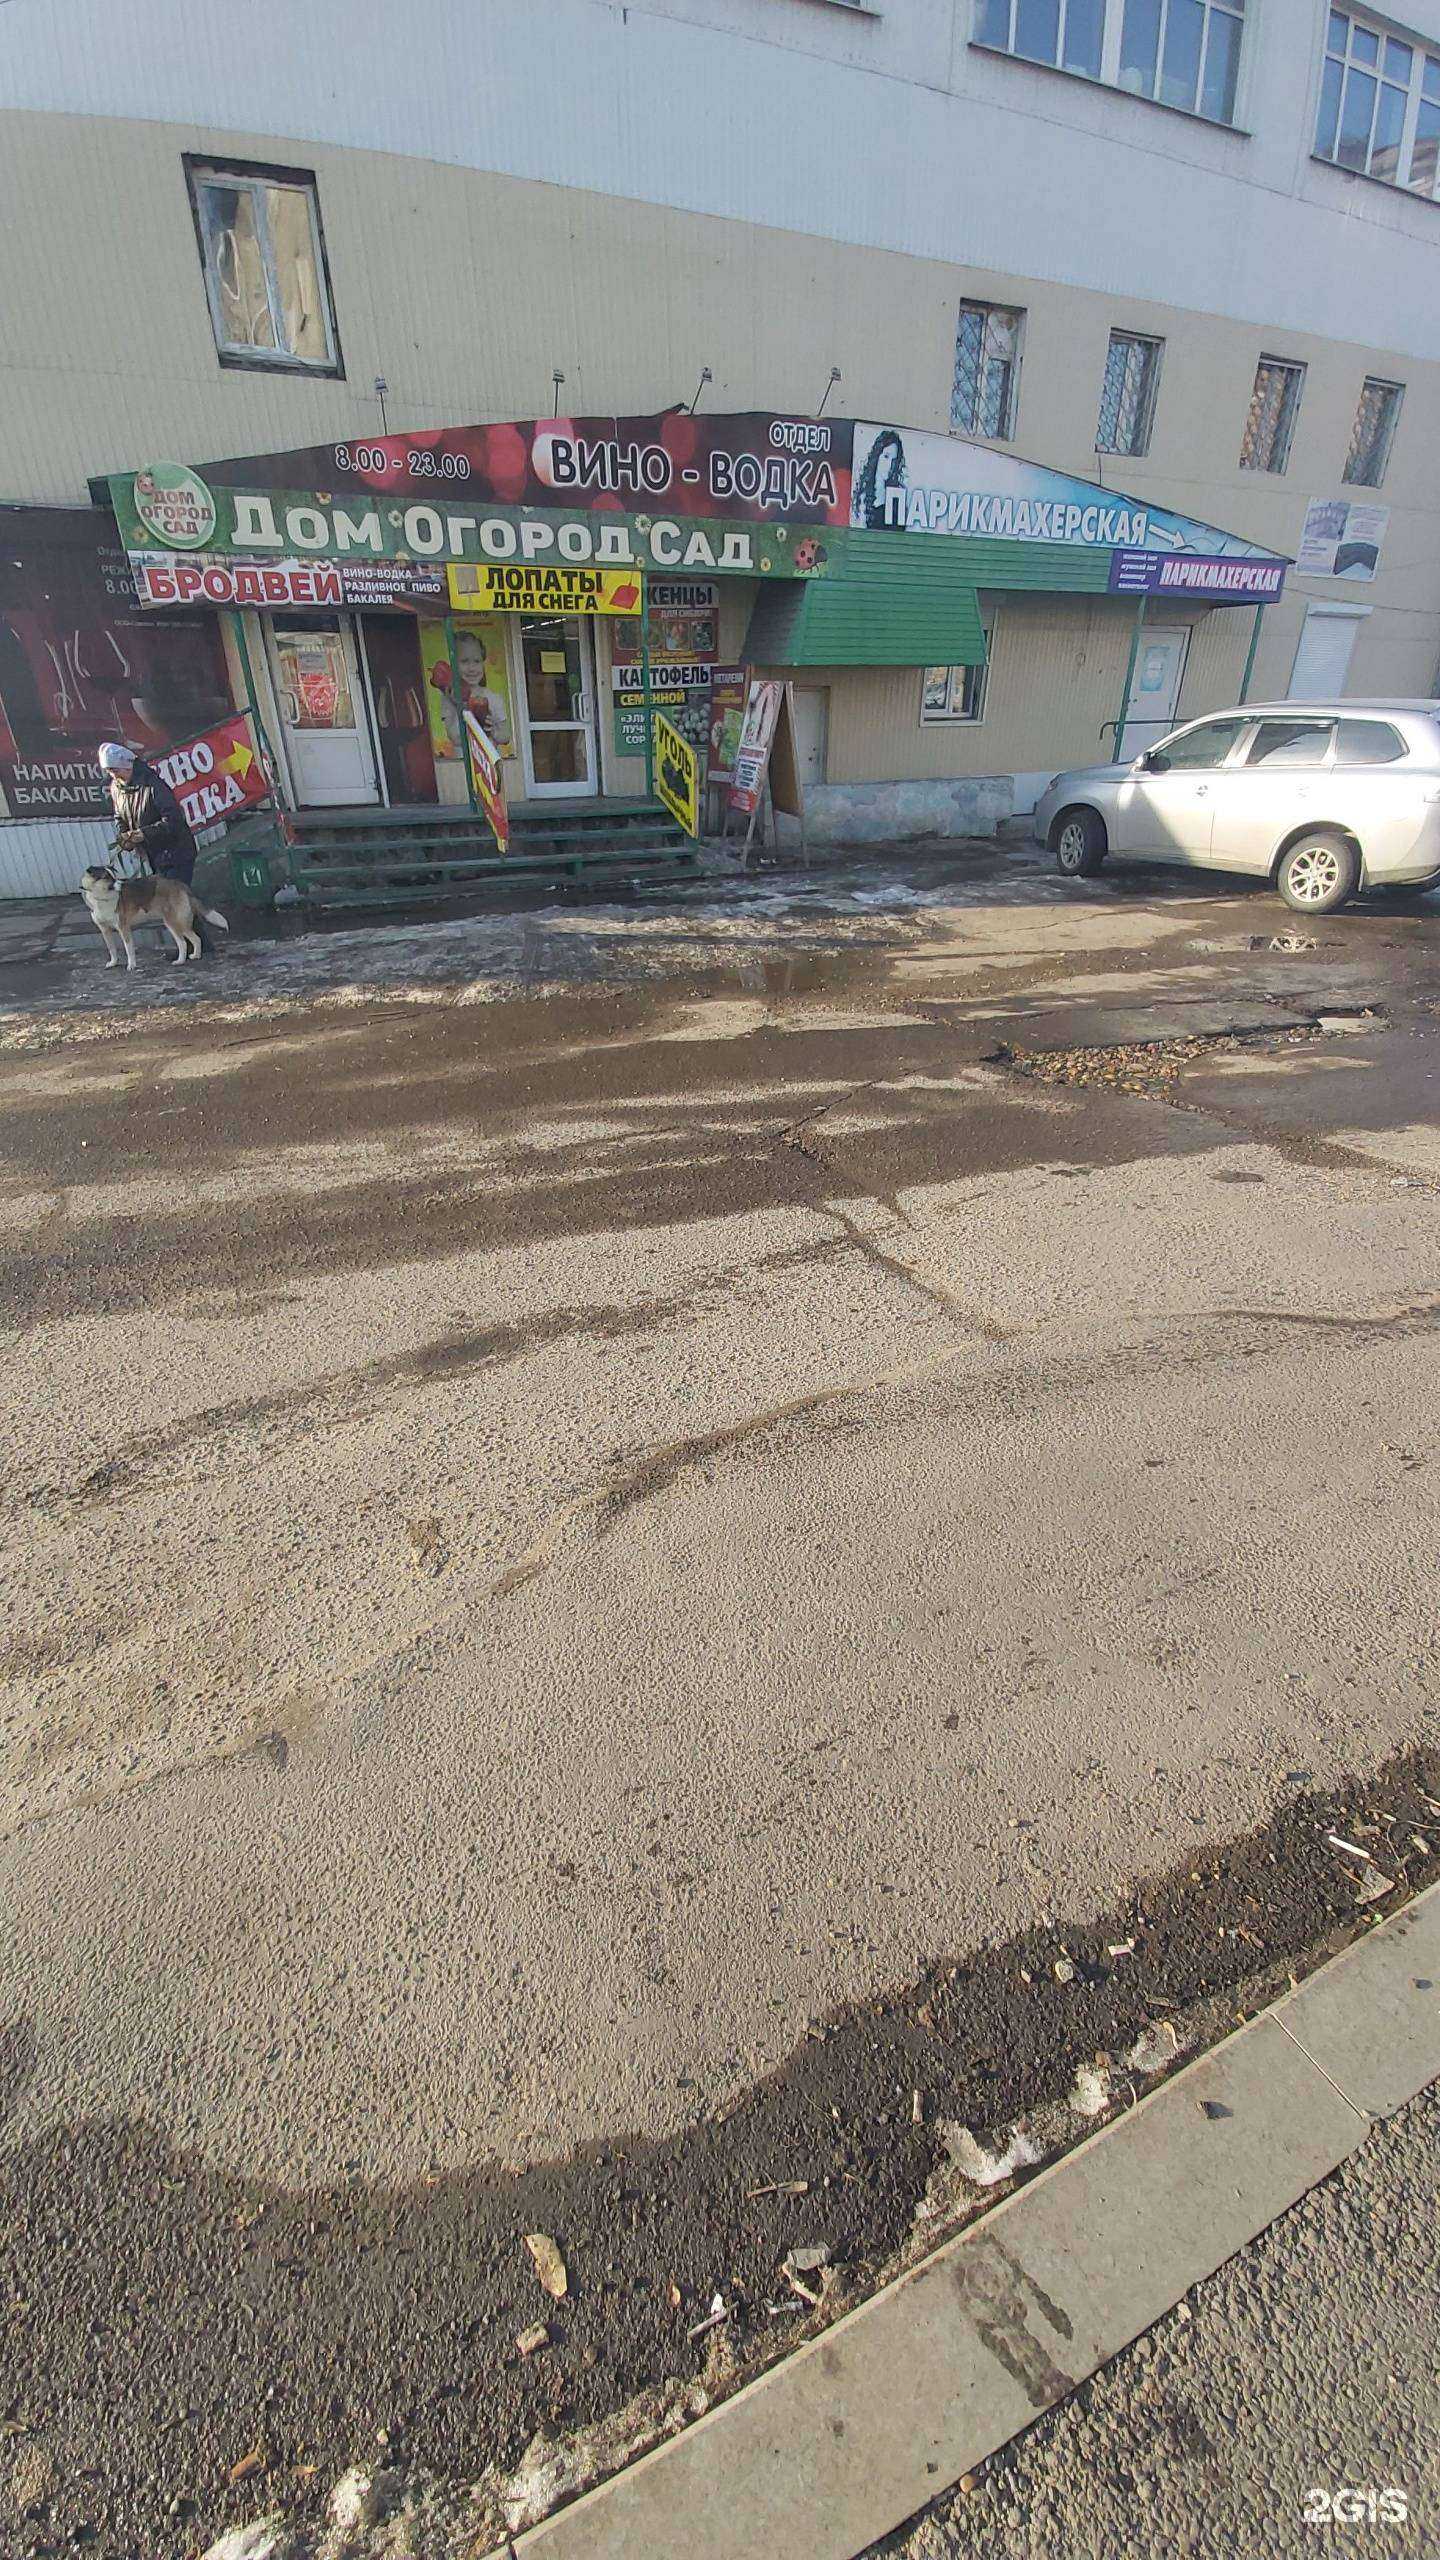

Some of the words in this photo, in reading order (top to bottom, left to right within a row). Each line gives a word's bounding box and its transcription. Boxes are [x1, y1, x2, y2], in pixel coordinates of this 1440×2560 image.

[770, 421, 832, 452] ОТДЕЛ
[335, 445, 386, 473] 8.00
[408, 451, 471, 480] 23.00
[550, 438, 673, 492] ВИНО
[710, 452, 837, 510] ВОДКА
[153, 490, 195, 505] ДОМ
[140, 505, 213, 521] ОГОРОД
[884, 486, 1148, 546] ПАРИКМАХЕРСКАЯ
[163, 520, 199, 534] САД
[144, 560, 343, 606] БРОДВЕЙ
[344, 582, 406, 592] РАЗЛИВНОЕ
[412, 583, 441, 593] ПИВО
[486, 567, 601, 594] ЛОПАТЫ
[1159, 562, 1282, 592] ПАРИКМАХЕРСКАЯ
[347, 594, 393, 604] БАКАЛЕЯ
[492, 591, 535, 609] ДЛЯ
[538, 593, 600, 611] СНЕГА
[620, 666, 709, 688] КАТОФЕЛЬ
[620, 691, 685, 706] СЕМННОЙ
[657, 718, 692, 779] УГОЛЬ
[180, 775, 246, 828] ДКА
